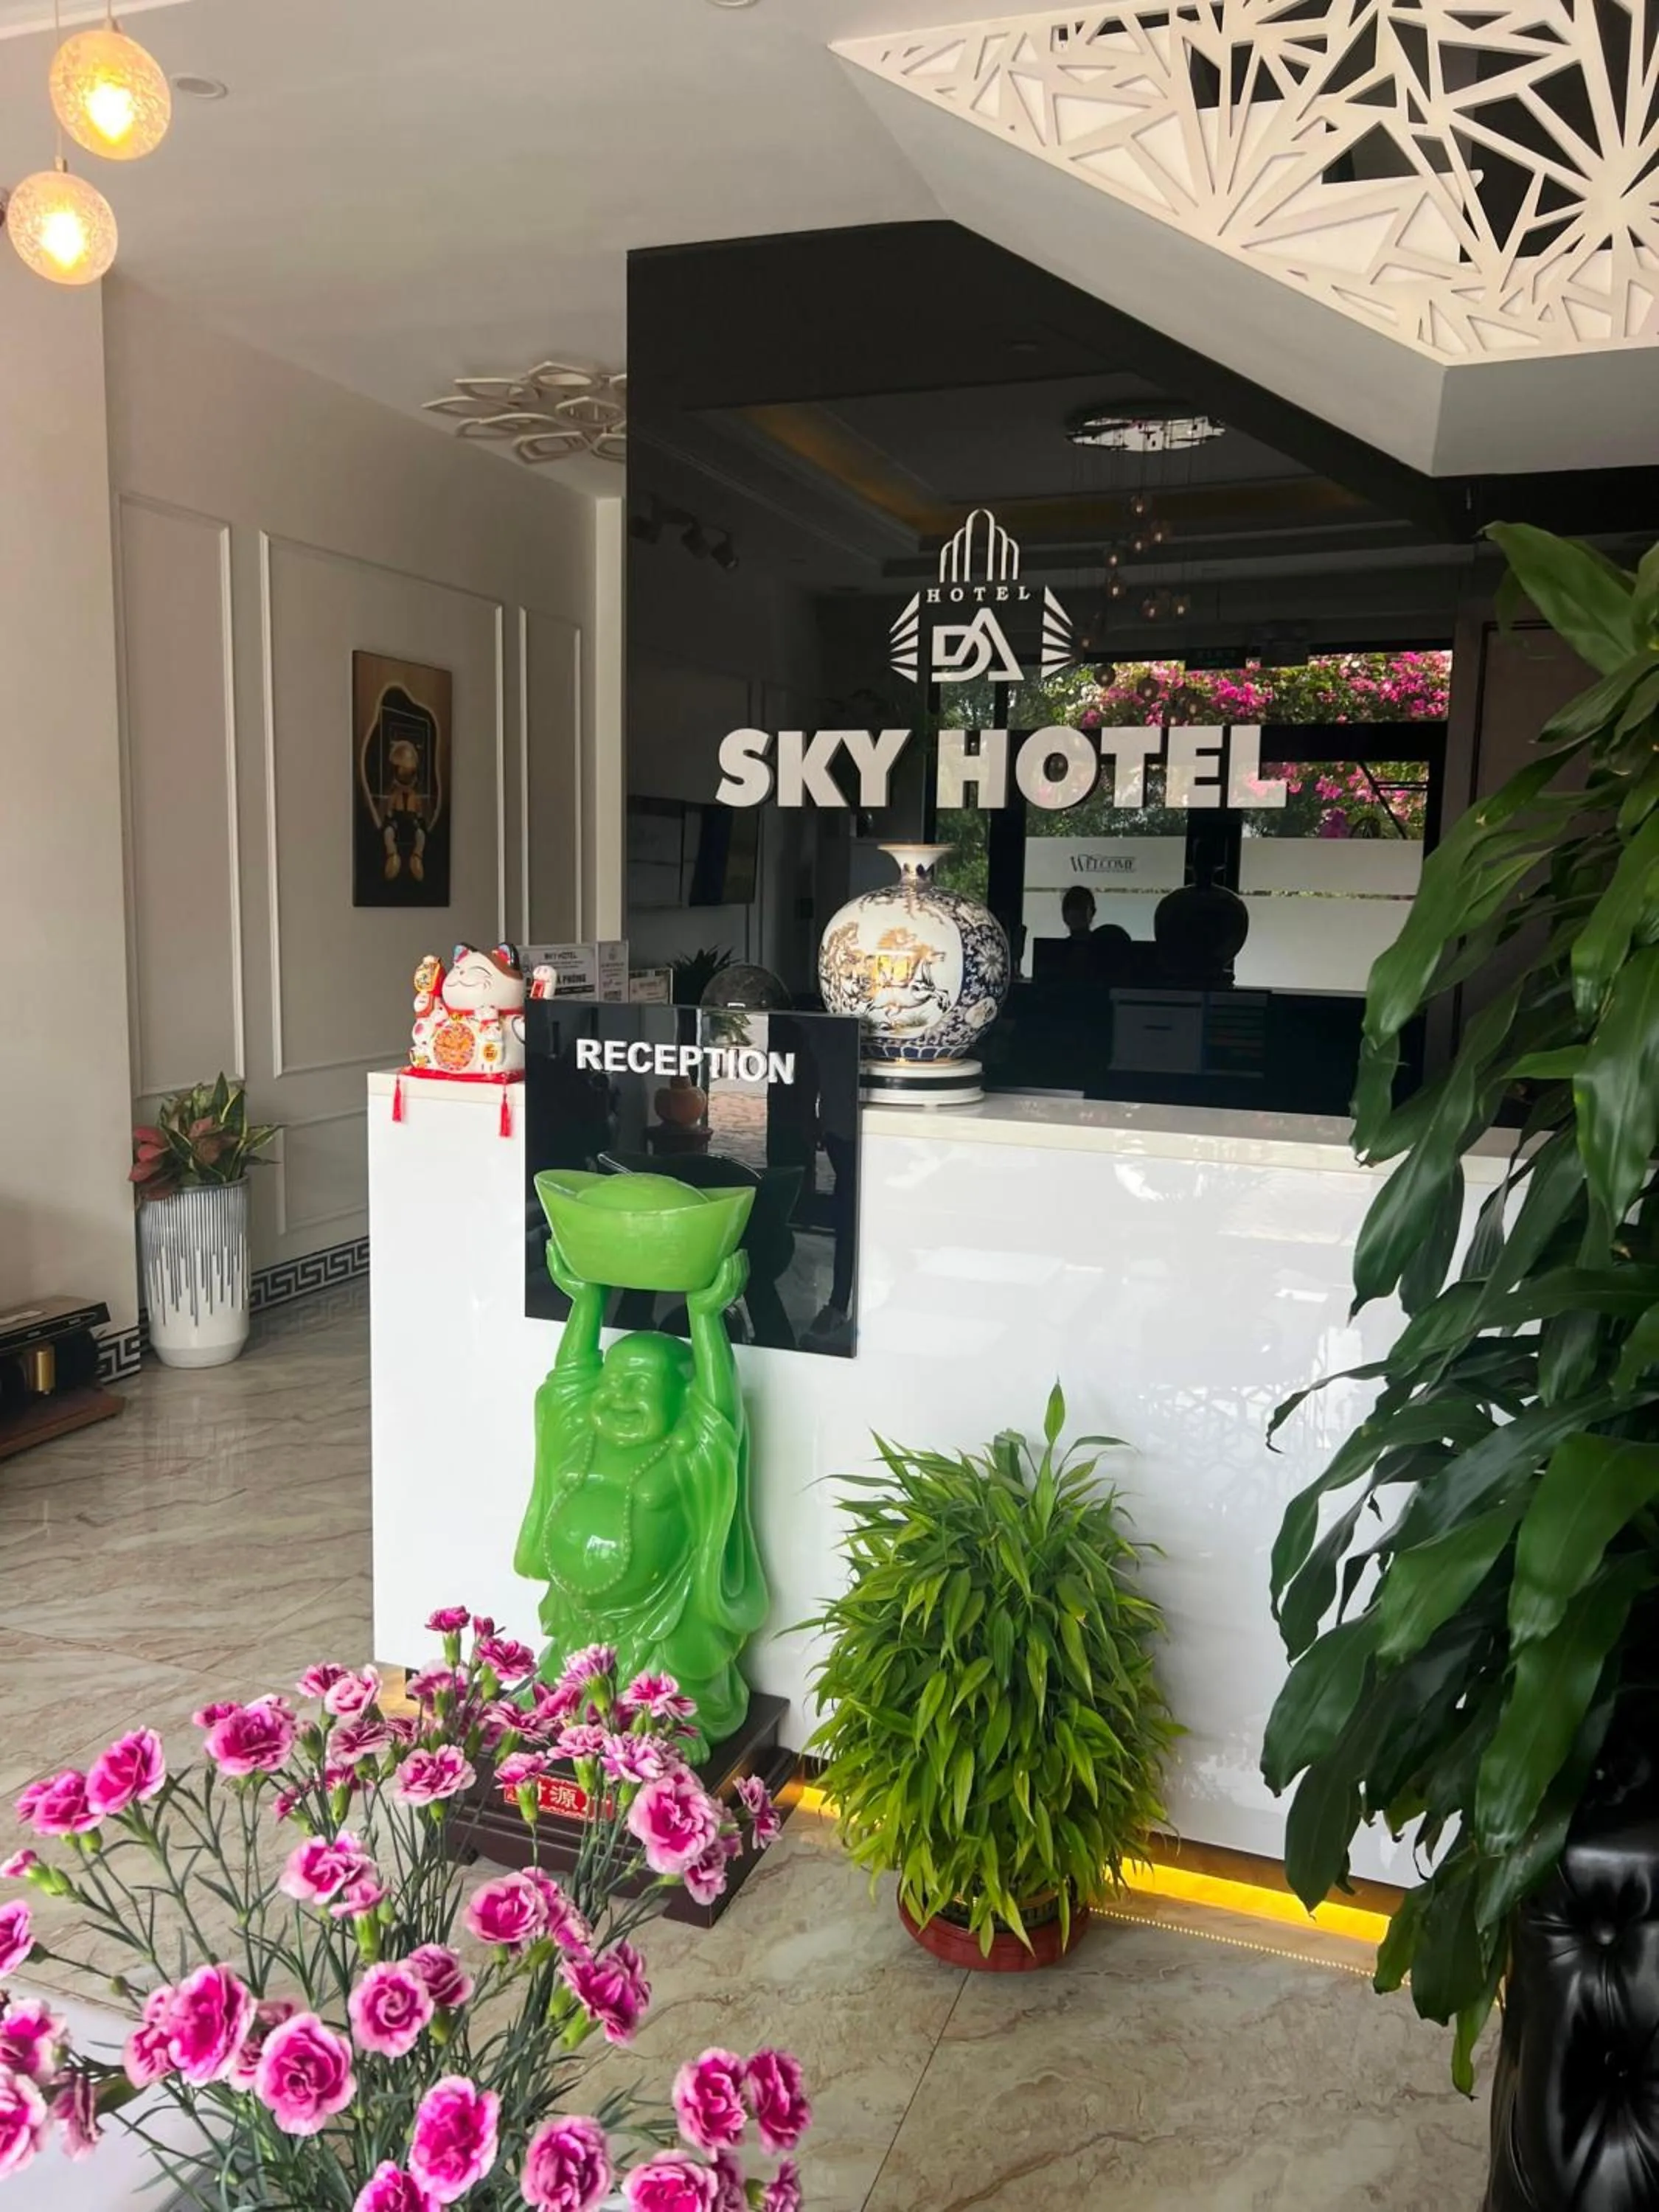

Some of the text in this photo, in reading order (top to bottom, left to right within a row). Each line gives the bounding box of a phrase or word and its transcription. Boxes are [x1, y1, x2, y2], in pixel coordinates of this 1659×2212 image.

[926, 585, 1031, 603] HOTEL
[714, 726, 1287, 809] SKY HOTEL
[575, 1037, 796, 1085] RECEPTION
